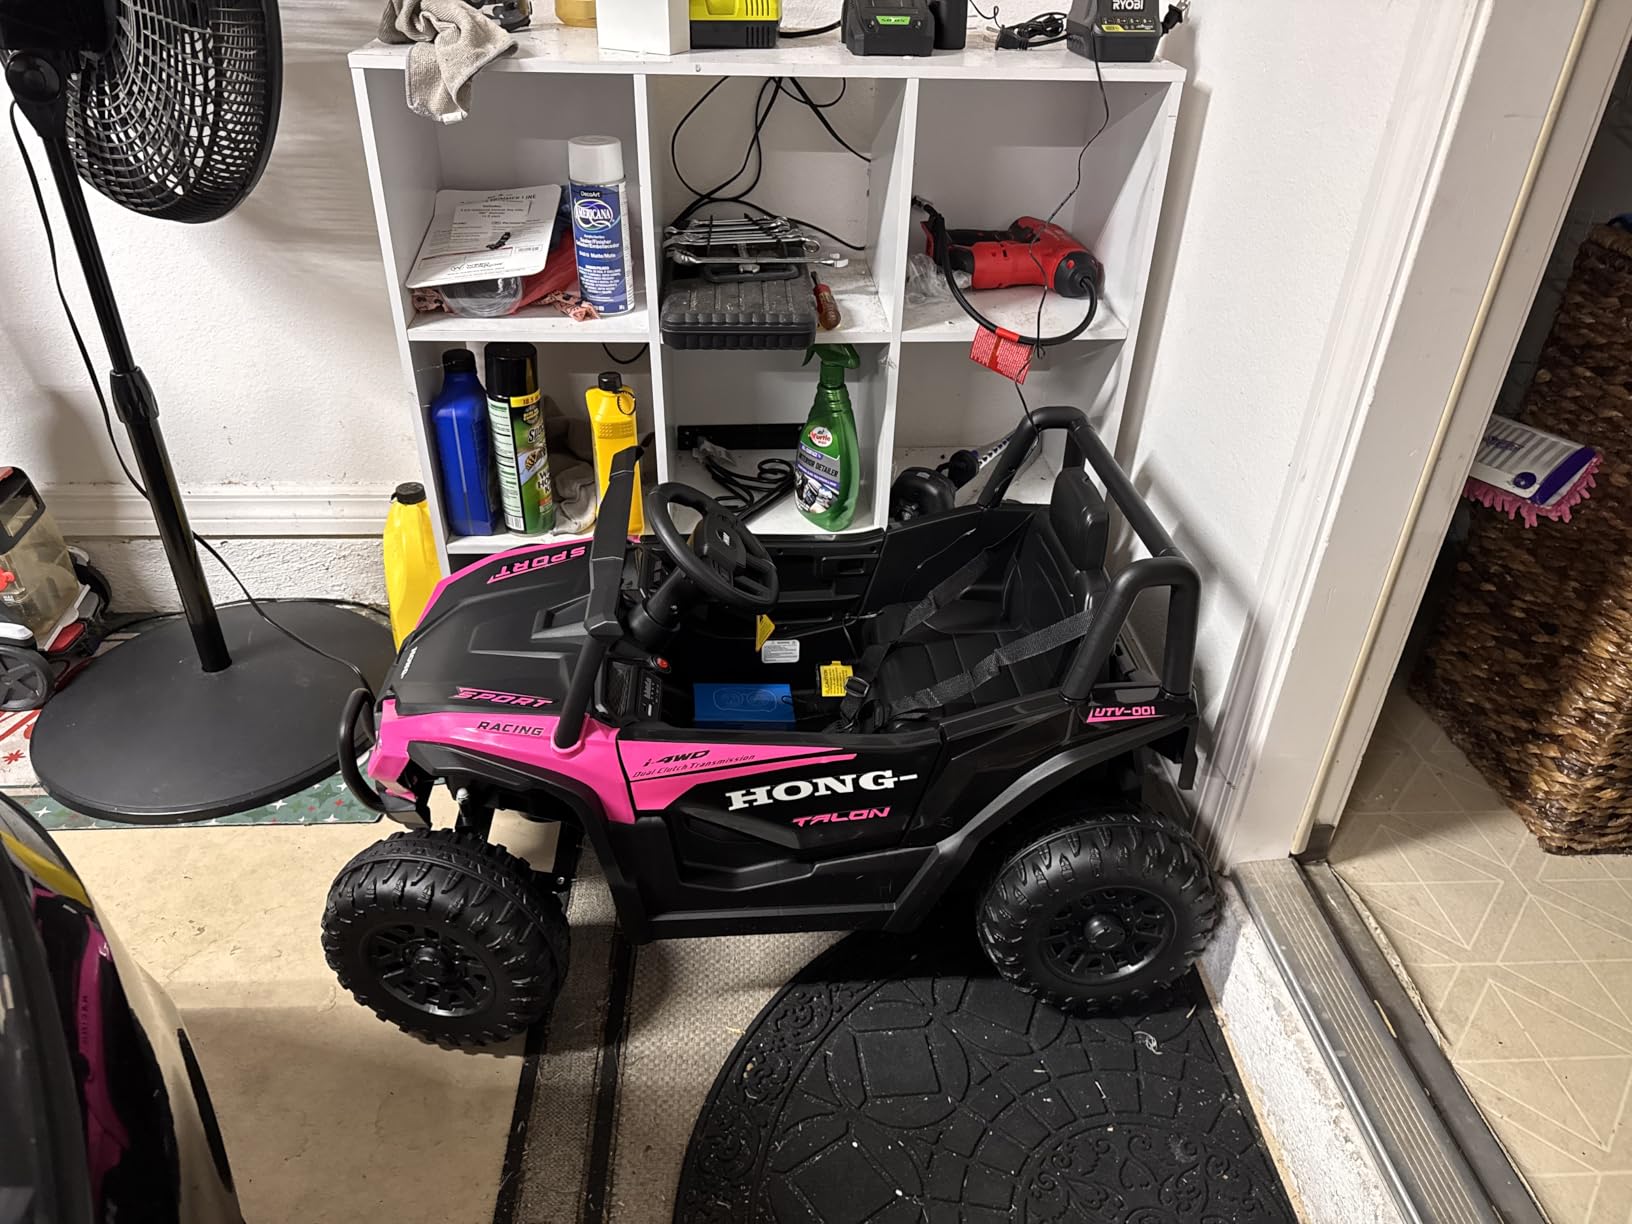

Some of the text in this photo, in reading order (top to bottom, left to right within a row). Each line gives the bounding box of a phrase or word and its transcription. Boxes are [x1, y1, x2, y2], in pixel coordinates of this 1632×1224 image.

[1113, 0, 1143, 10] RYOBI
[574, 205, 611, 220] AMERICANA
[809, 431, 831, 441] Turtle
[815, 462, 839, 477] DETAILER
[494, 545, 586, 578] SPORT
[450, 688, 554, 709] SPORT
[1094, 705, 1156, 717] UTV-001
[477, 721, 544, 736] RACING
[632, 754, 756, 778] Dual Clutch Transmission
[791, 806, 891, 828] TALON
